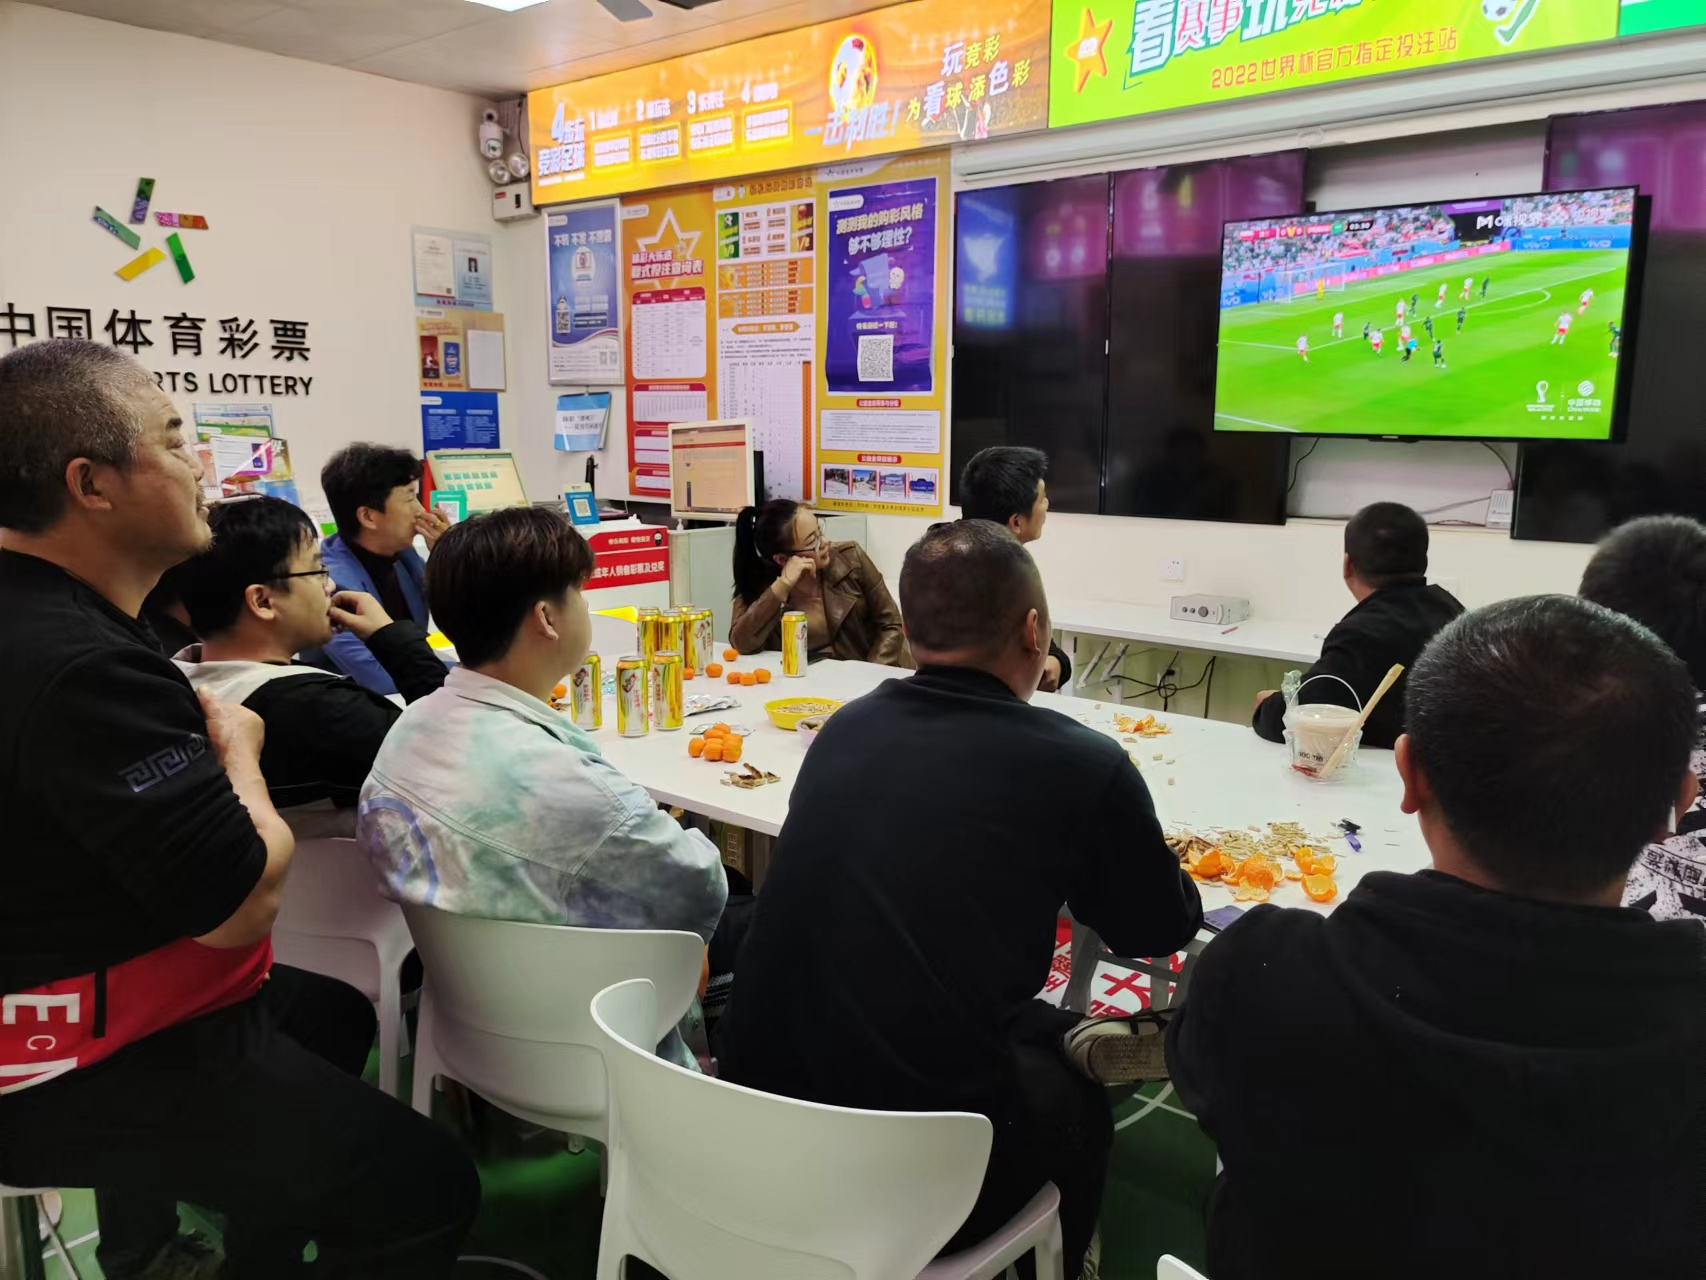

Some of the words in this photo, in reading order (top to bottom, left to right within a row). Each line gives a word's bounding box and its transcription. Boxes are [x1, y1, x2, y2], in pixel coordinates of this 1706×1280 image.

[941, 35, 1000, 77] 玩竞彩
[1212, 28, 1459, 89] 2022世界杯官方指定投注站
[906, 59, 1031, 123] 为看球添色彩
[848, 226, 913, 255] 够不够理性?
[0, 302, 311, 362] 中国体育彩票
[209, 372, 313, 396] LOTTERY
